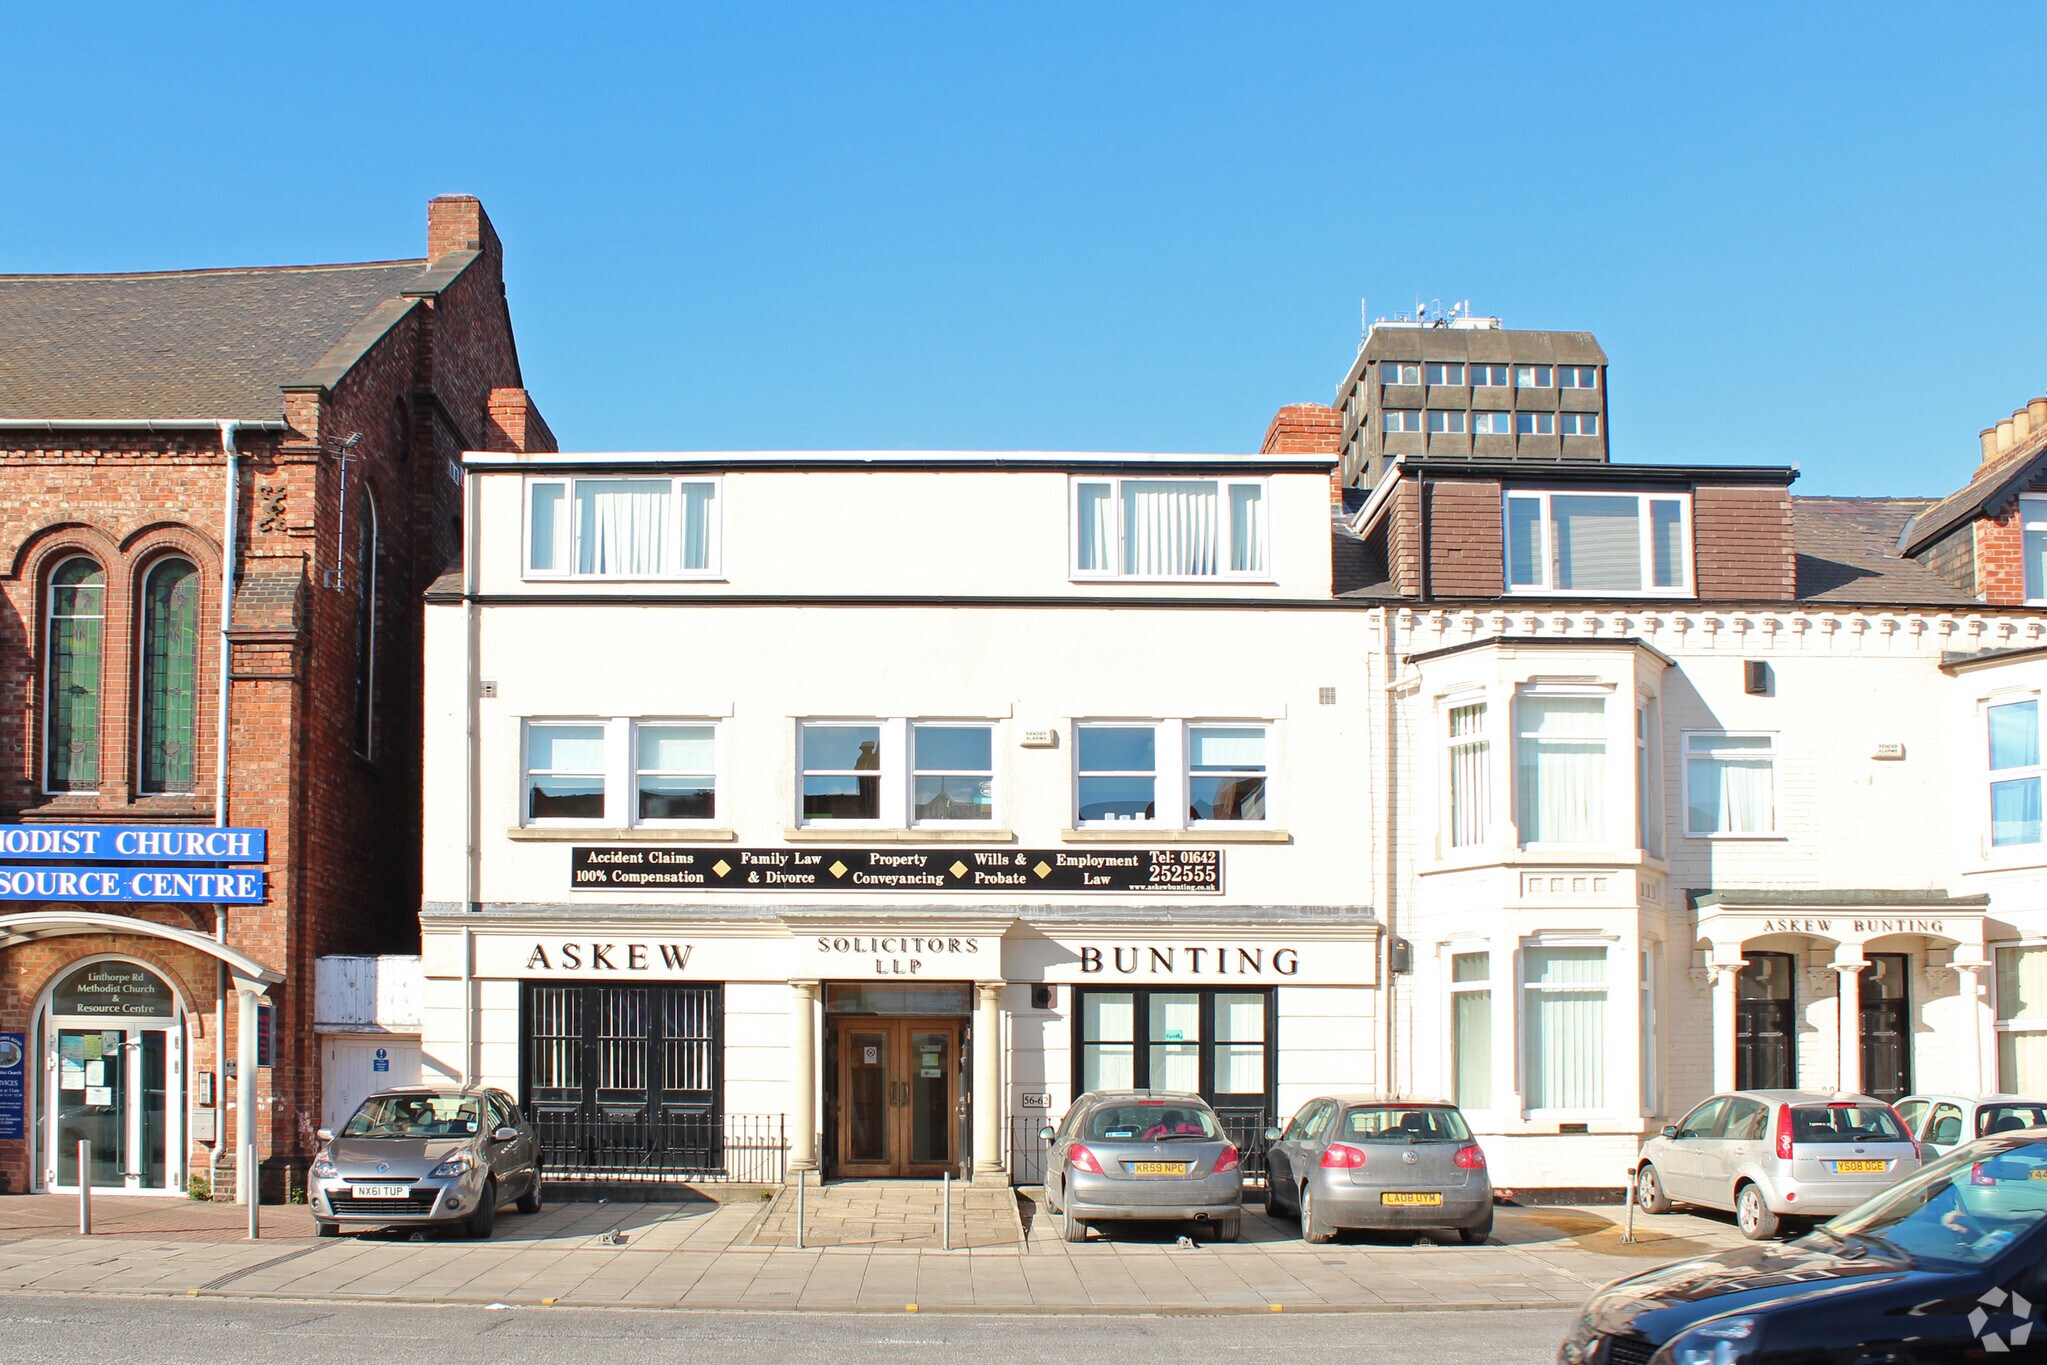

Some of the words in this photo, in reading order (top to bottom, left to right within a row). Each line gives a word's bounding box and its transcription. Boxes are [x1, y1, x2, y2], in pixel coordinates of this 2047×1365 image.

[115, 831, 252, 856] CHURCH
[587, 852, 644, 864] Accident
[649, 852, 694, 864] Claims
[740, 852, 789, 866] Family
[794, 853, 822, 865] Law
[869, 853, 928, 868] Property
[974, 853, 1010, 866] Wills
[1014, 853, 1027, 866] &
[1056, 854, 1139, 869] Employment
[1149, 851, 1175, 863] Tel:
[1180, 852, 1216, 863] 01642
[576, 870, 606, 882] 100%
[612, 870, 705, 884] Compensation
[747, 871, 760, 883] &
[766, 871, 815, 883] Divorce
[853, 872, 944, 887] Conveyancing
[974, 872, 1027, 885] Probate
[1083, 873, 1112, 886] Law
[1149, 865, 1216, 882] 252555
[131, 872, 257, 898] CENTRE
[1763, 919, 1833, 932] ASKEW
[1854, 919, 1944, 932] BUNTING
[818, 937, 979, 953] SOLICITORS
[526, 942, 695, 972] ASKEW
[1080, 947, 1300, 976] BUNTING
[876, 959, 923, 975] LLP
[88, 973, 130, 983] Linthorpe
[132, 973, 144, 981] Rd
[77, 984, 121, 993] Methodist
[123, 984, 155, 993] Church
[112, 994, 120, 1002] &
[77, 1004, 120, 1012] Resource
[122, 1004, 155, 1012] Centre
[1024, 1096, 1049, 1105] 56-62
[1136, 1164, 1162, 1172] KR59
[1165, 1164, 1184, 1173] NPC
[1838, 1161, 1863, 1171] YS08
[358, 1186, 381, 1196] NX61
[384, 1186, 403, 1196] TUP
